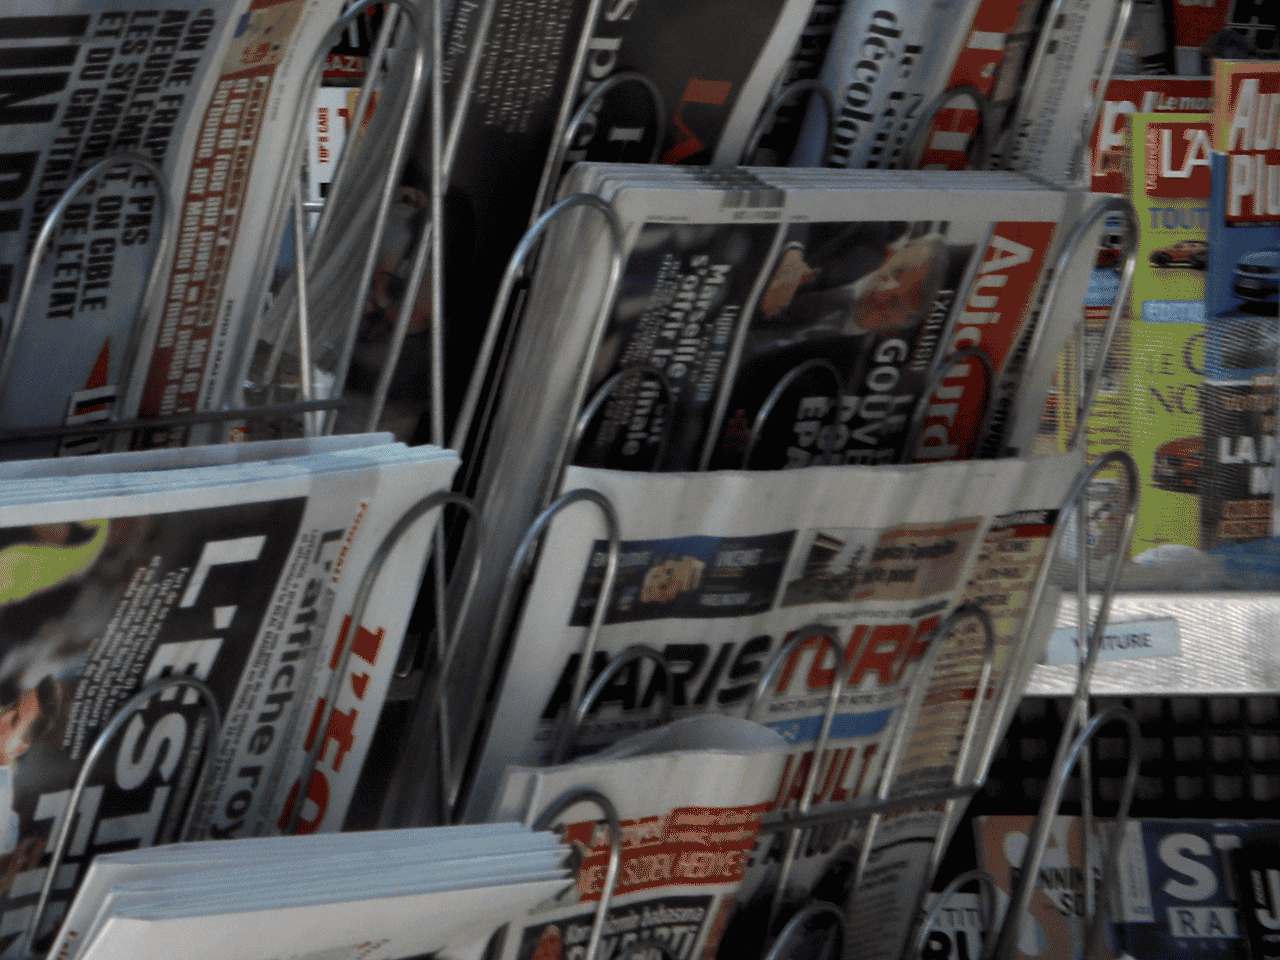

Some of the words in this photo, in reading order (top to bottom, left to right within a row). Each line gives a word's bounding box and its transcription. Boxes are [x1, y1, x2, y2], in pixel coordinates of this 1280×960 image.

[97, 11, 122, 38] ET
[119, 10, 160, 55] LES
[78, 48, 115, 80] DU
[164, 57, 201, 90] NE
[60, 203, 92, 235] DE
[91, 195, 124, 231] ON
[119, 195, 156, 247] PAS
[77, 236, 118, 313] CIBLE
[541, 634, 773, 721] PARIS
